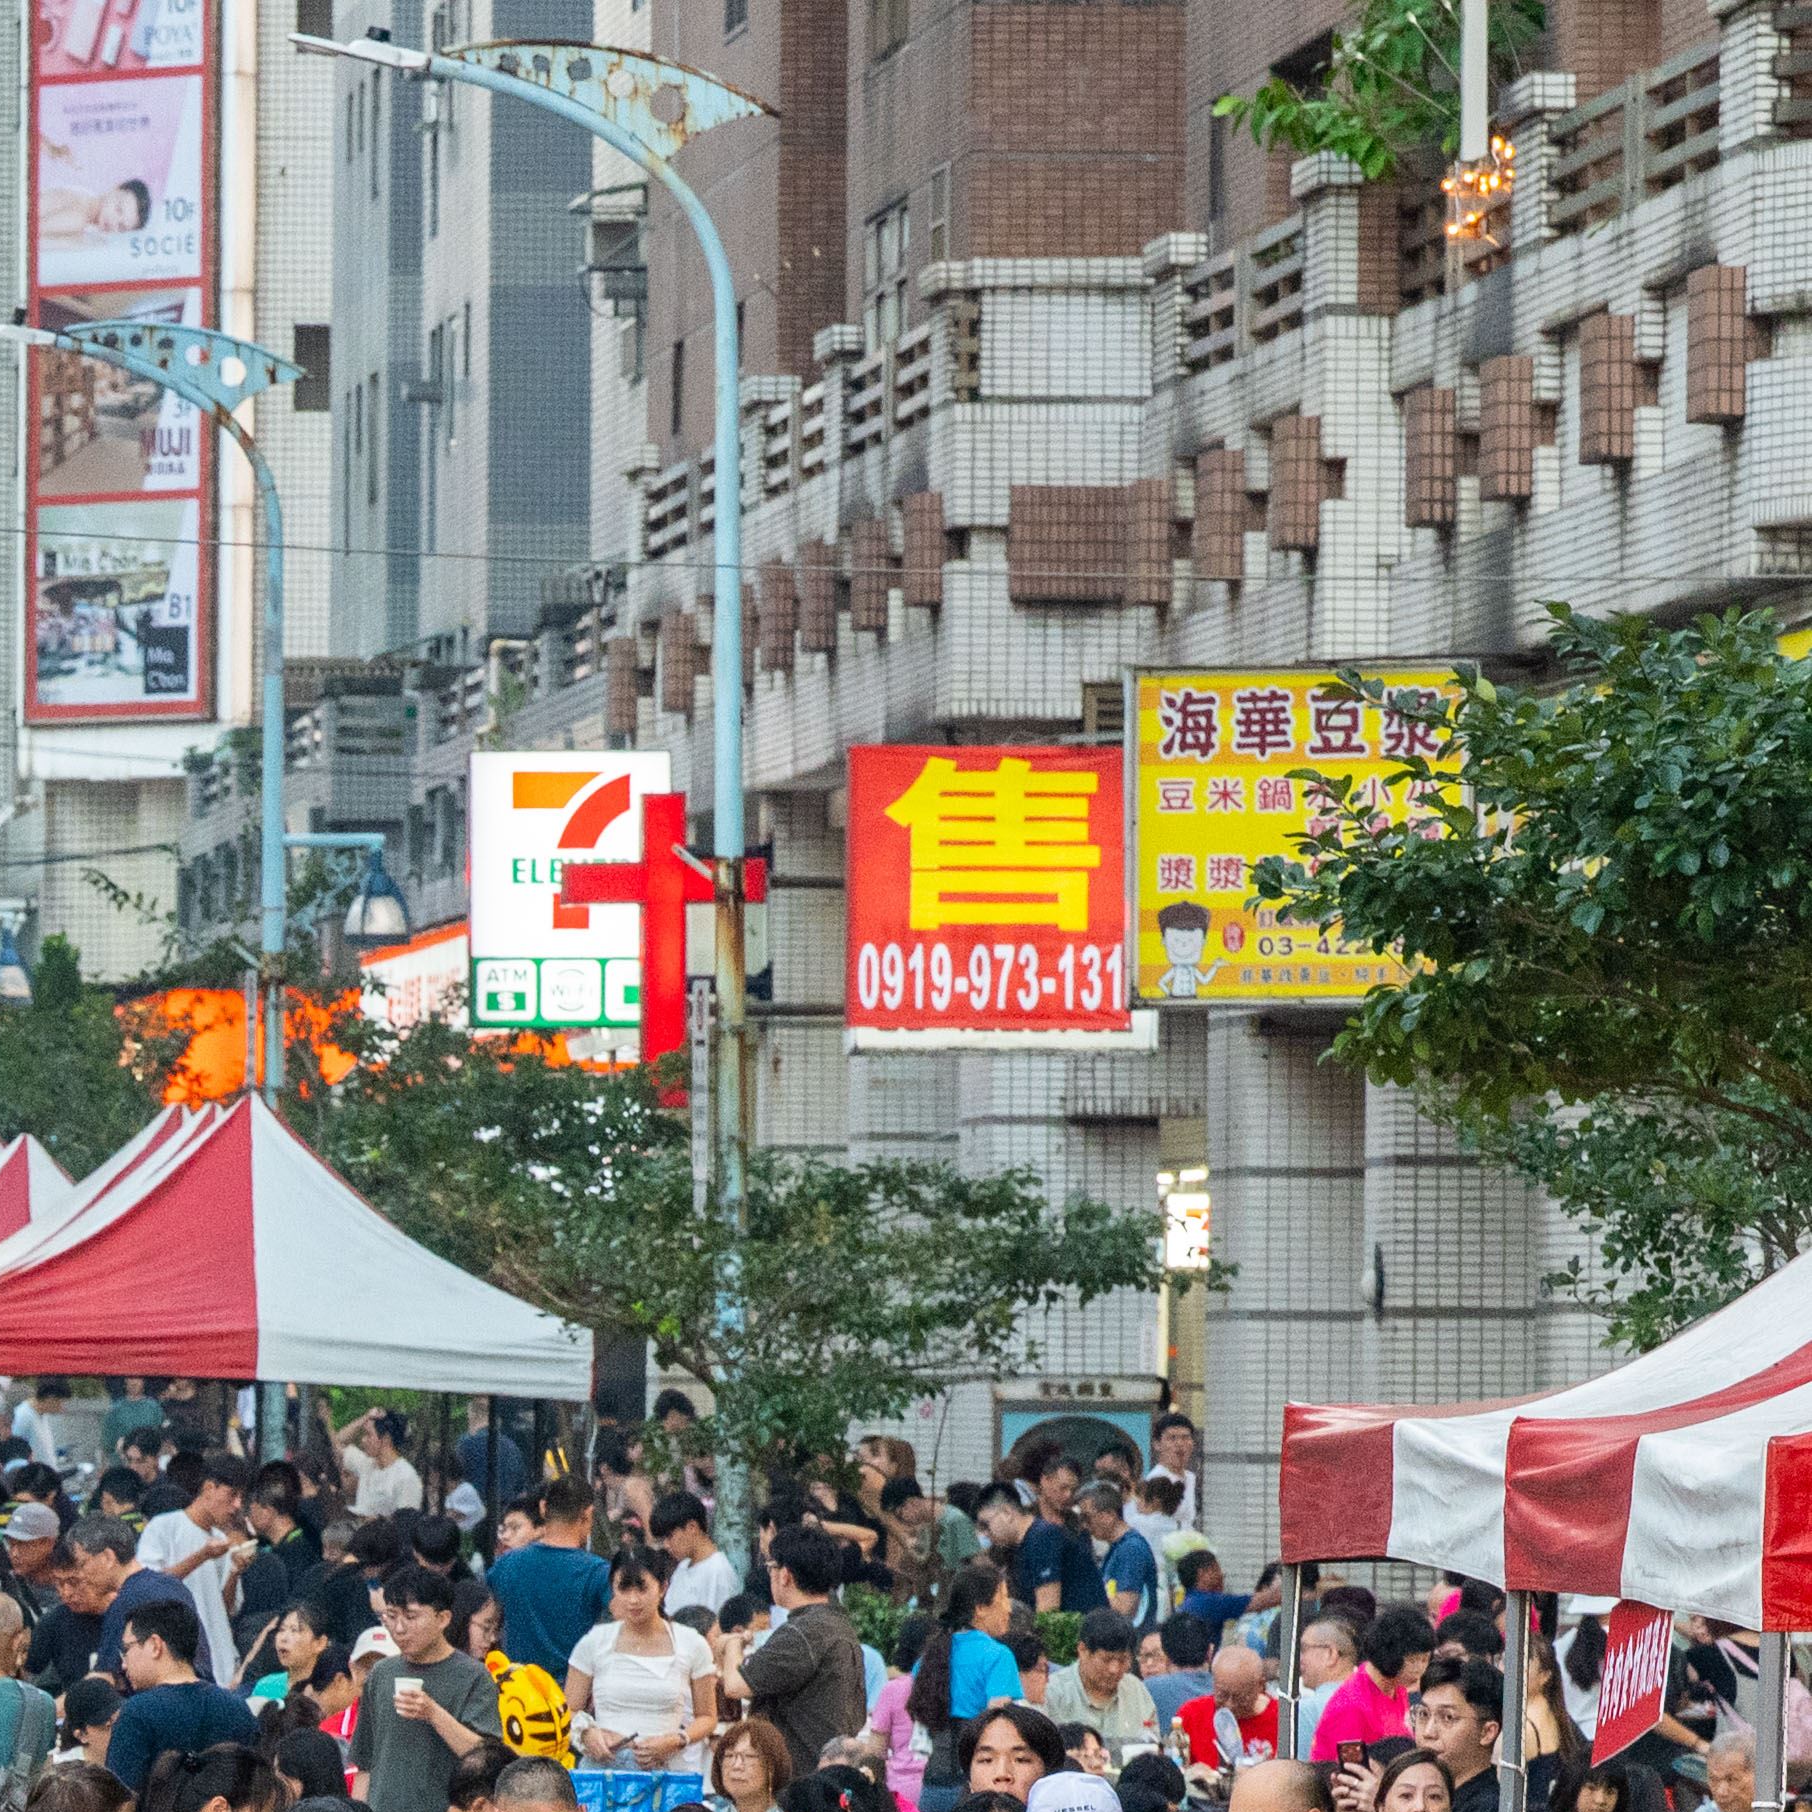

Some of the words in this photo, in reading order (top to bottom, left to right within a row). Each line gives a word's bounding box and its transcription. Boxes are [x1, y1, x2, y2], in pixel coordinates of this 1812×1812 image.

[140, 426, 191, 457] MUJI
[884, 755, 1101, 932] 售
[486, 968, 527, 983] ATM
[857, 942, 1124, 1012] 0919-973-131
